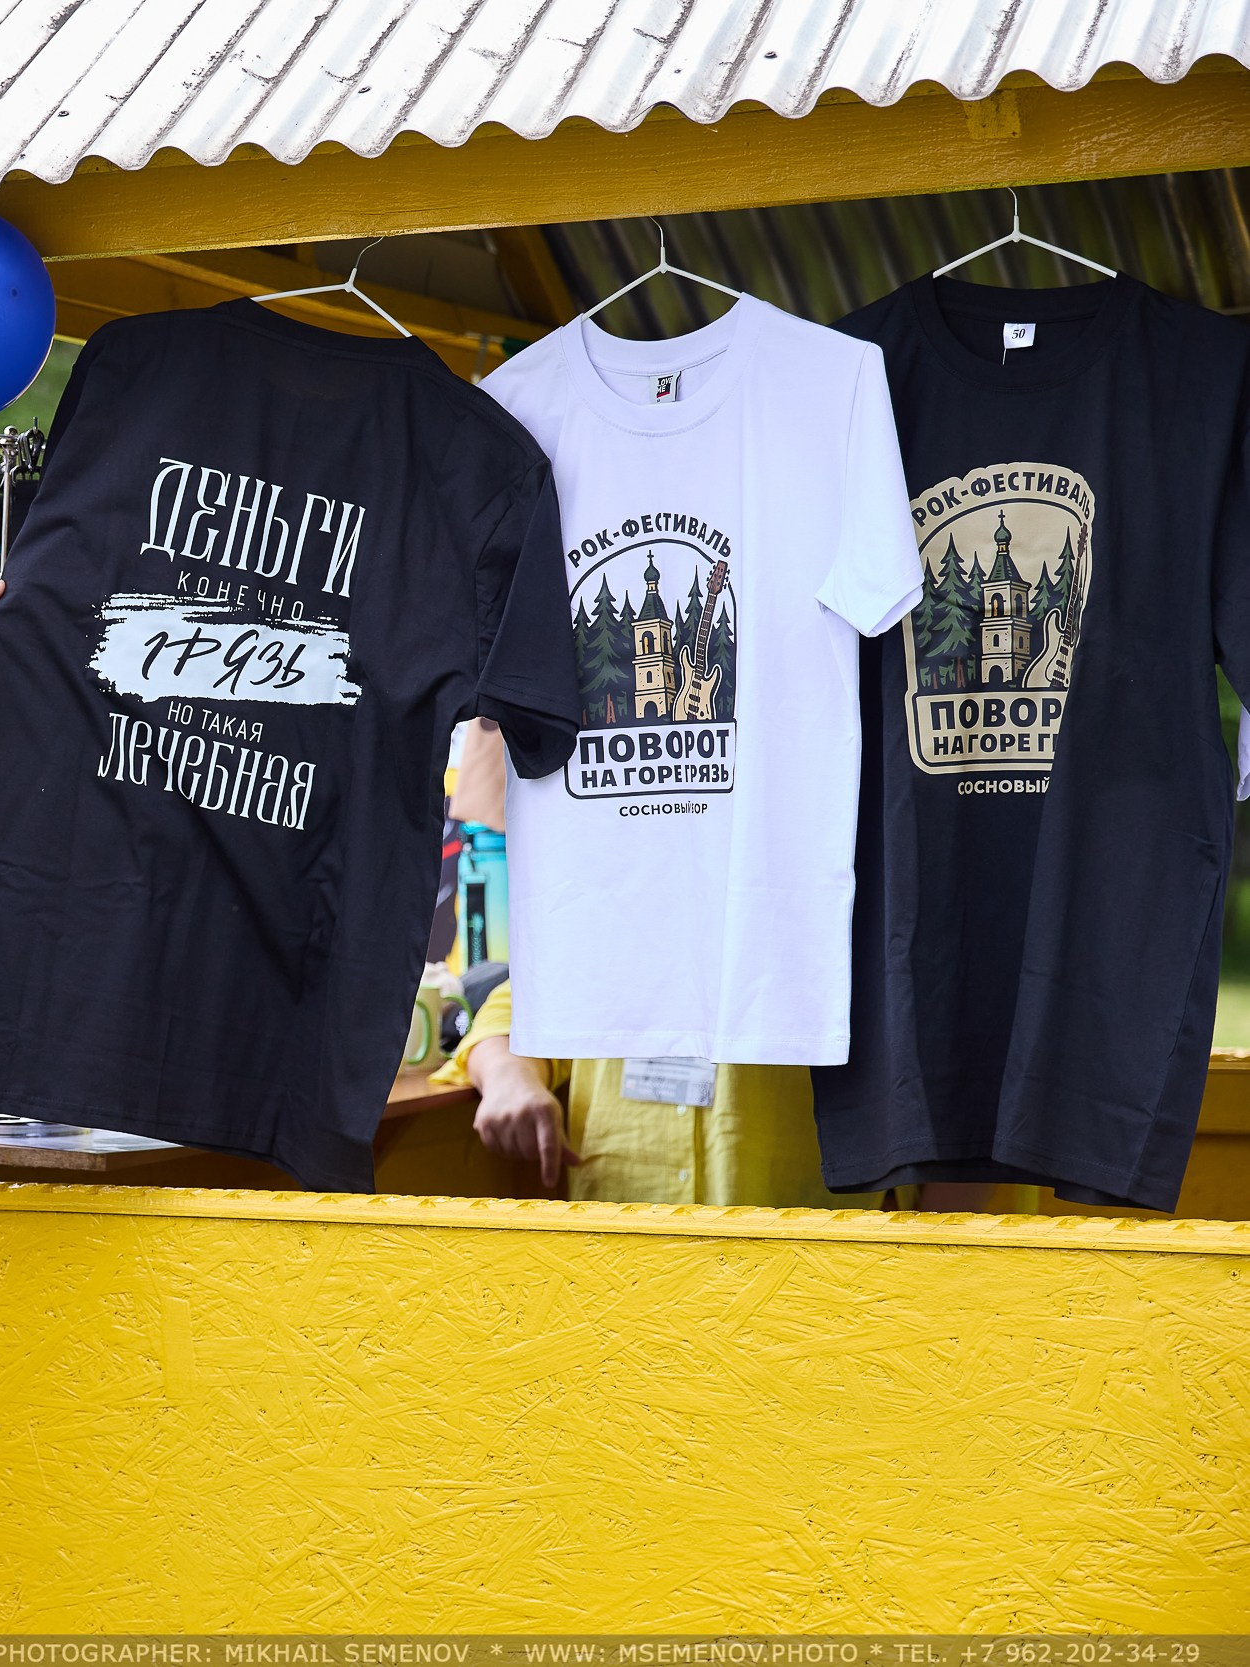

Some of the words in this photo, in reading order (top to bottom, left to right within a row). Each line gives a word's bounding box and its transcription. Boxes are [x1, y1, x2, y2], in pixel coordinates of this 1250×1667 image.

[1012, 328, 1026, 339] 50
[911, 471, 1090, 528] РОК-ФЕСТИВАЛЬ
[140, 457, 366, 598] ДЕНЬГИ
[567, 512, 732, 568] РОК-ФЕСТИВАЛЬ
[177, 570, 304, 621] КОНЕЧНО
[141, 626, 307, 695] ГРЯЗЬ
[168, 700, 194, 725] НО
[201, 708, 264, 743] ТАКАЯ
[932, 735, 963, 756] НА
[967, 733, 1031, 754] ГОРЕ
[579, 729, 730, 765] ПОВОРОТ
[581, 769, 618, 789] НА
[623, 764, 683, 786] ГОРЕ
[684, 763, 730, 783] ГРЯЗЬ
